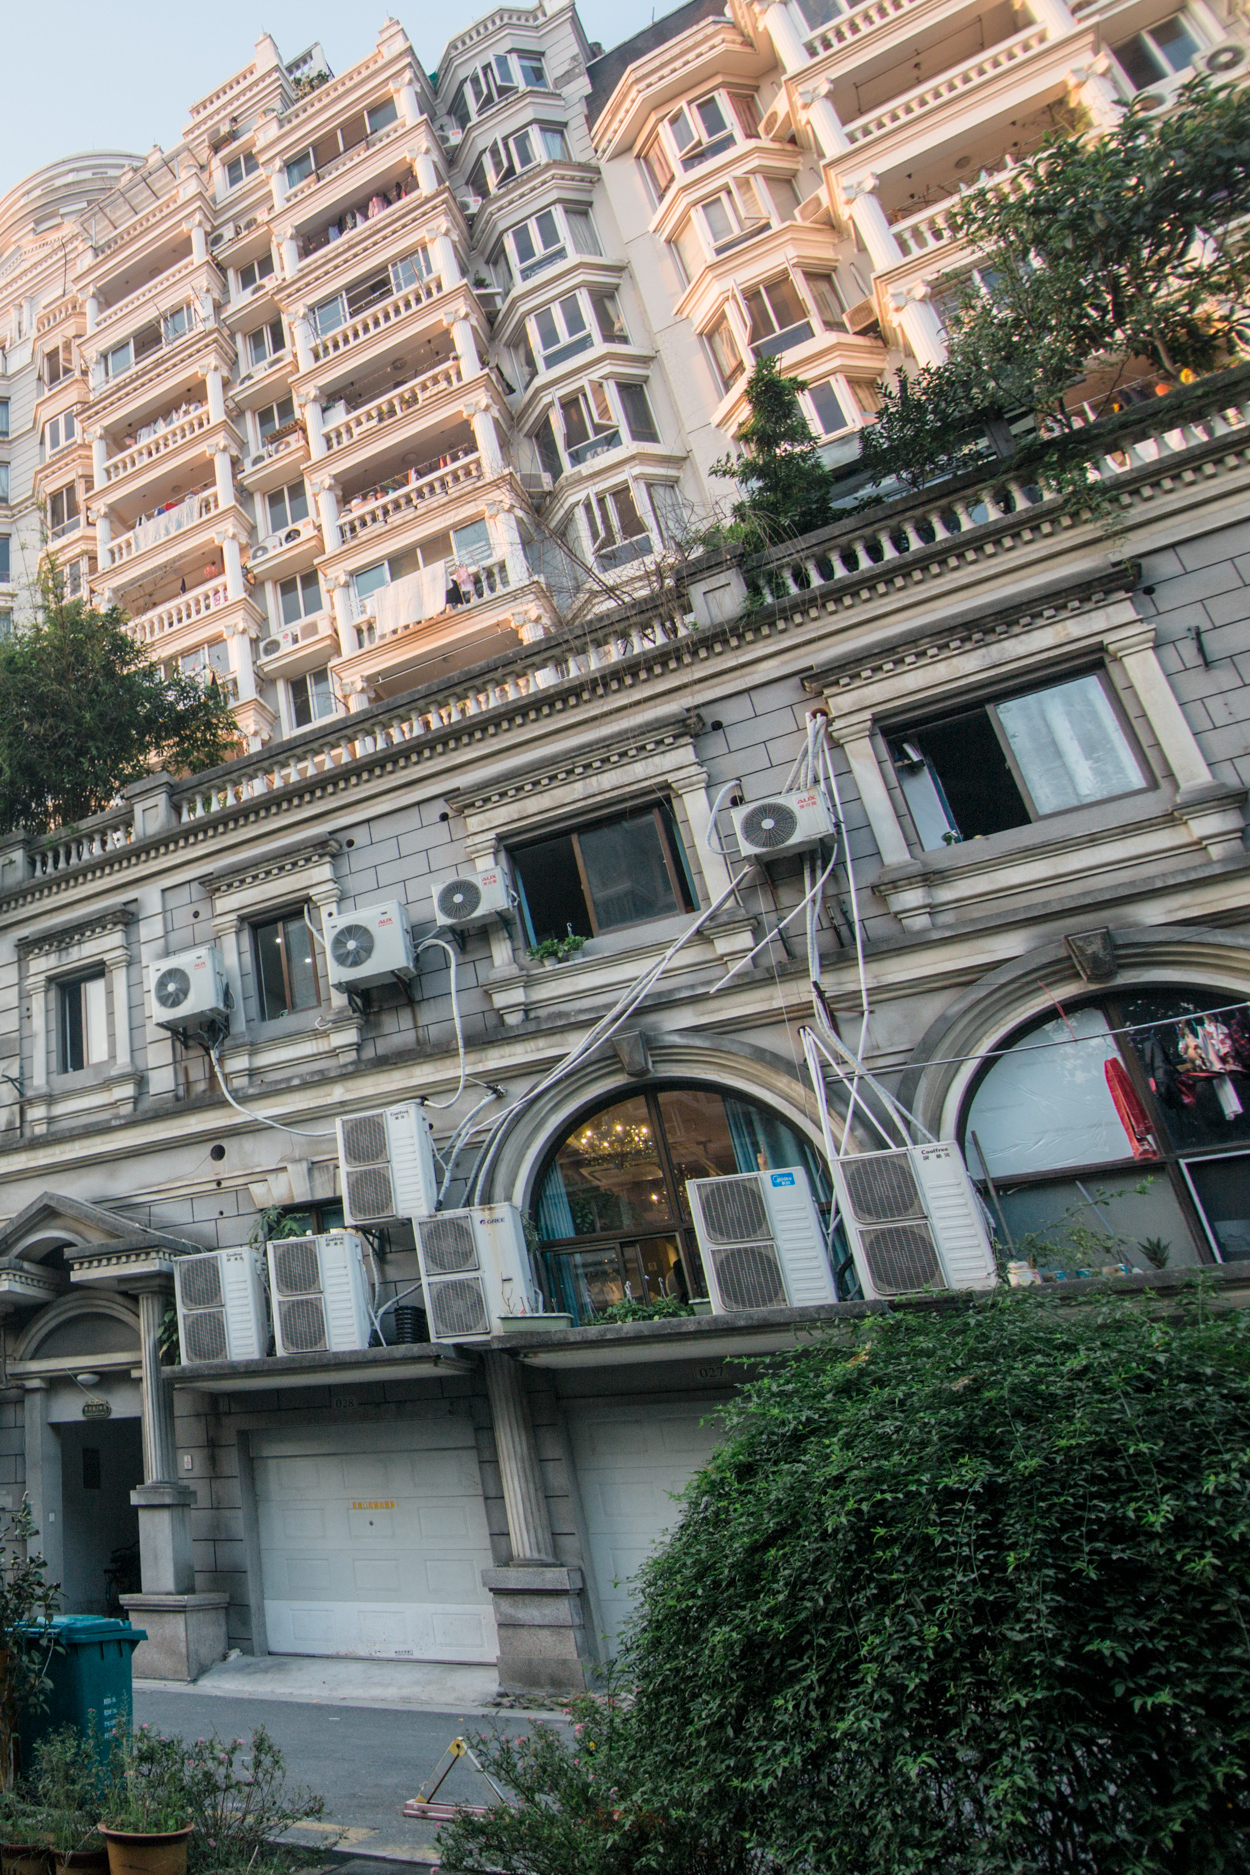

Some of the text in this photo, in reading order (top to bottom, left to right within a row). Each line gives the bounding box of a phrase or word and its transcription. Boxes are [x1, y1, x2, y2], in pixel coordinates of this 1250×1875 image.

[797, 795, 816, 804] AUX
[921, 1147, 949, 1155] Coolfree
[699, 1366, 723, 1379] 027
[336, 1398, 354, 1408] 028
